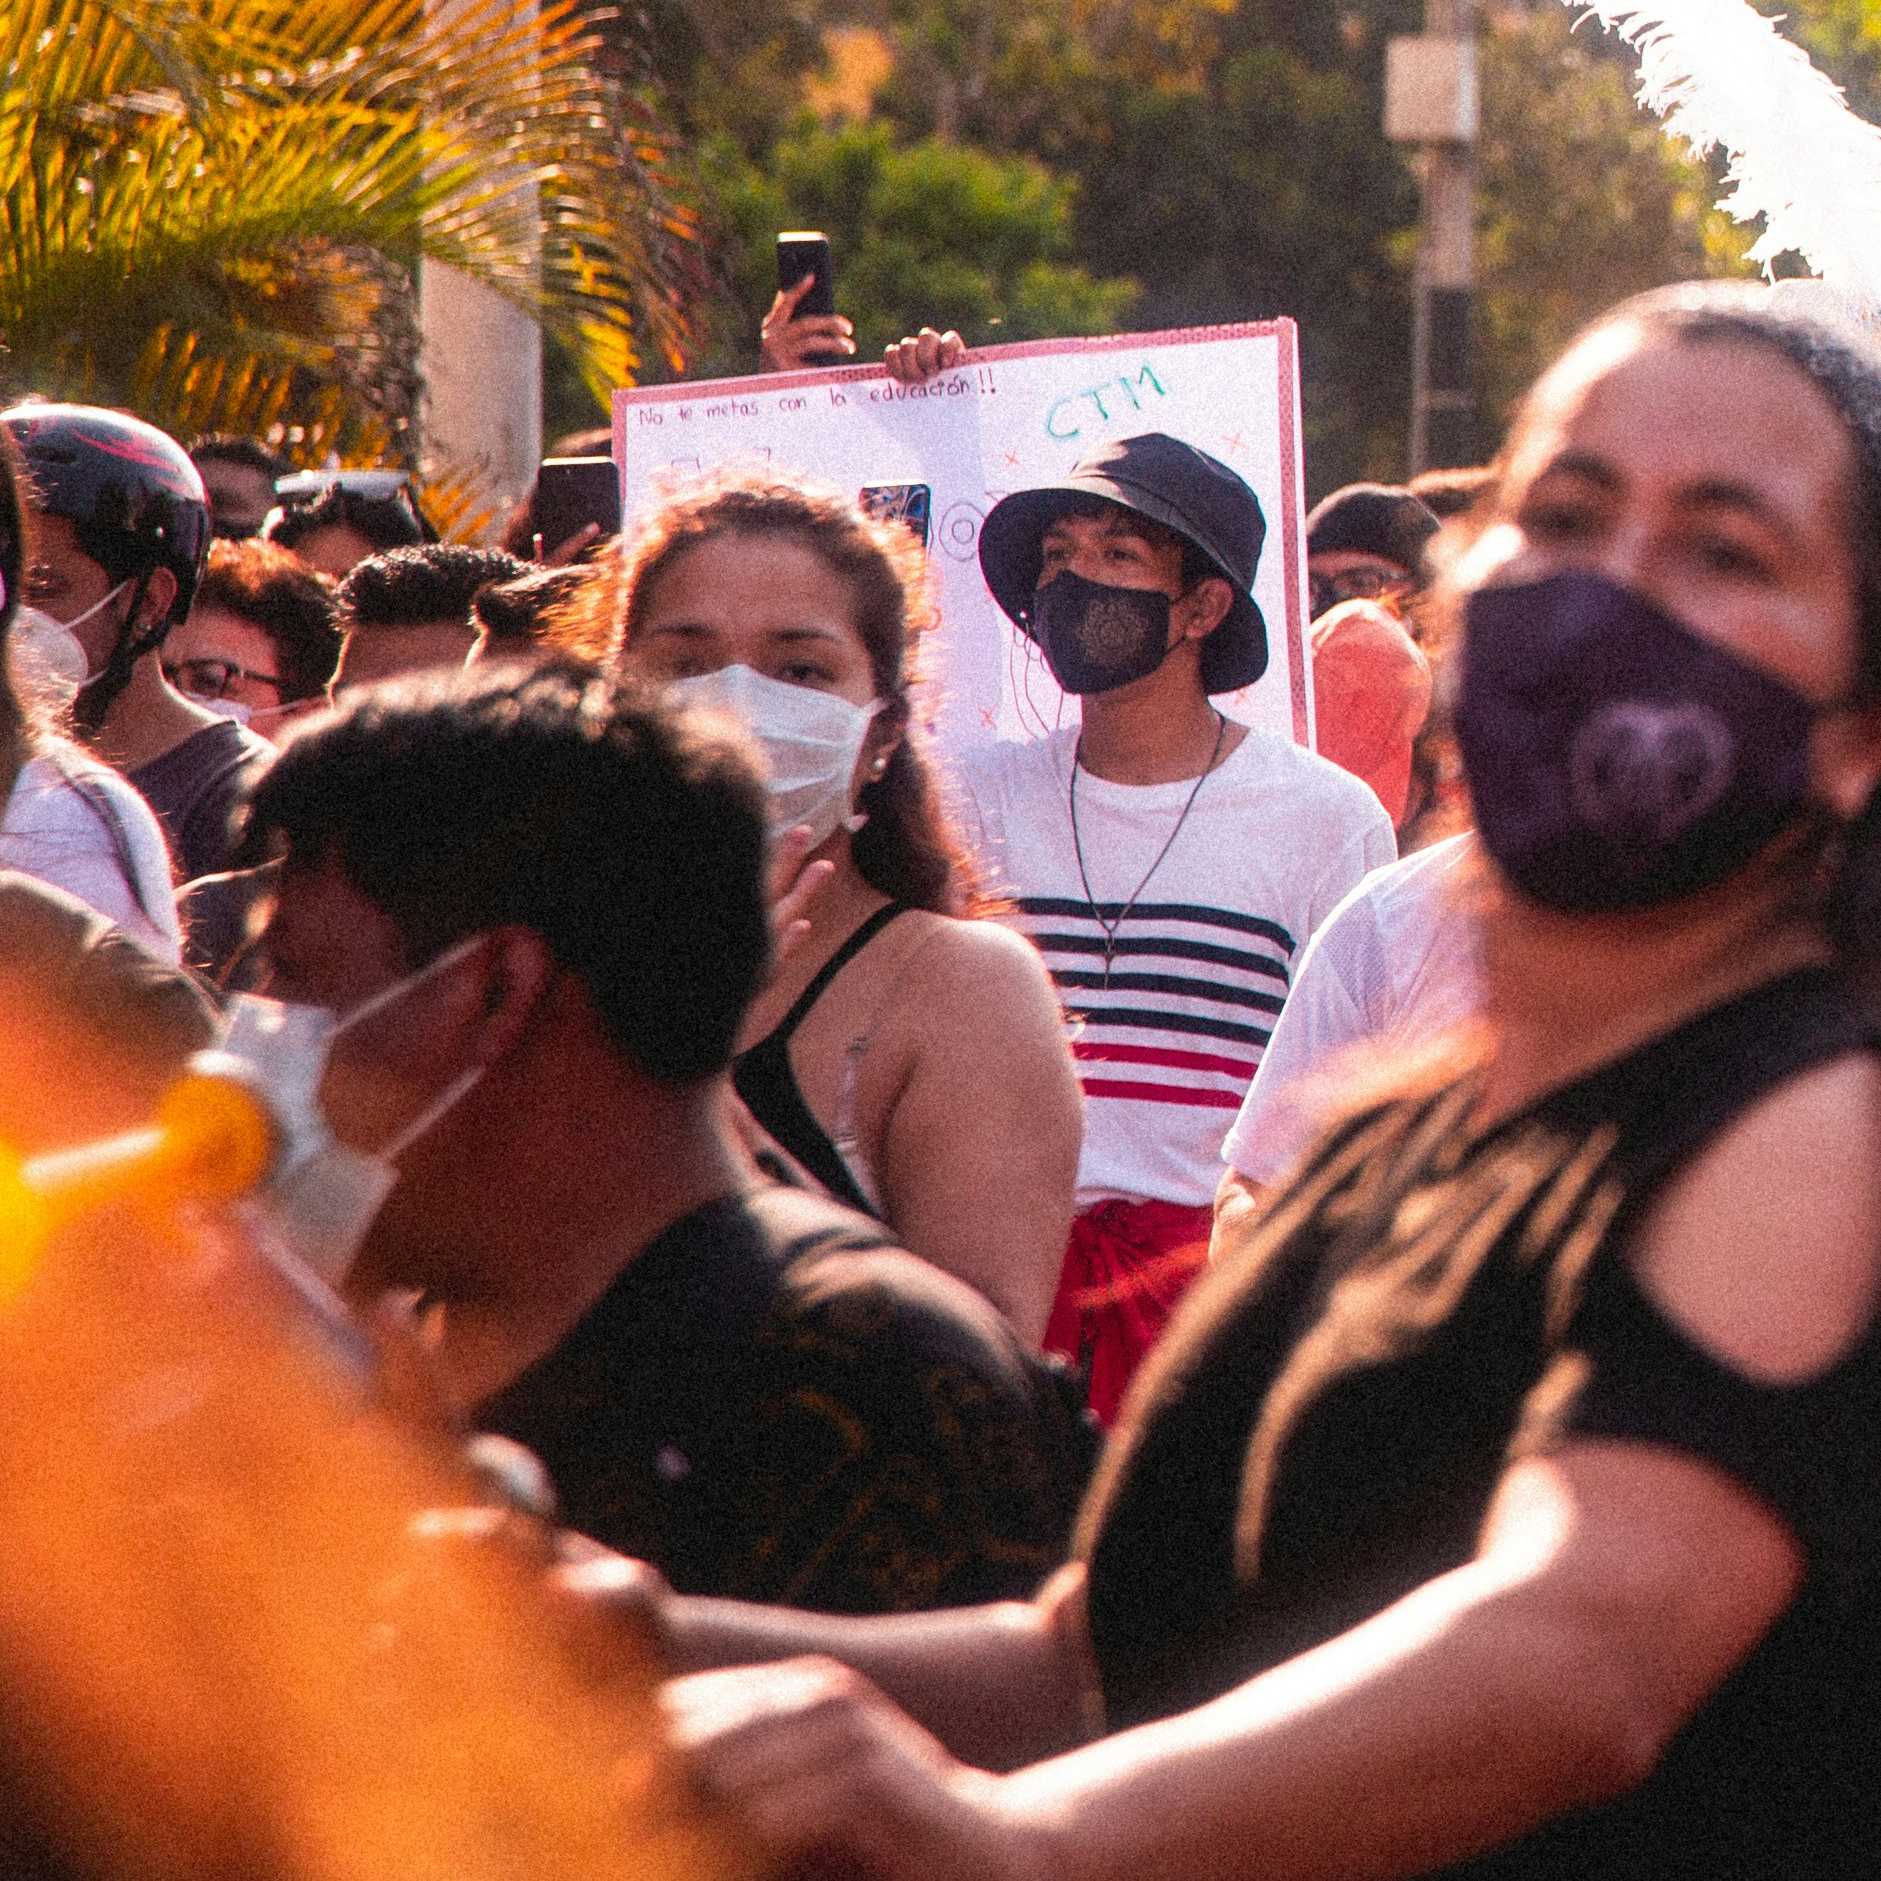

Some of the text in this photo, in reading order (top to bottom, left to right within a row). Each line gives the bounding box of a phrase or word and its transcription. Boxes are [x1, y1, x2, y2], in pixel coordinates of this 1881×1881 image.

[638, 407, 664, 427] No
[677, 406, 694, 421] te
[706, 398, 760, 421] metas
[778, 396, 808, 412] con
[828, 386, 848, 409] la
[1045, 359, 1169, 444] CTM
